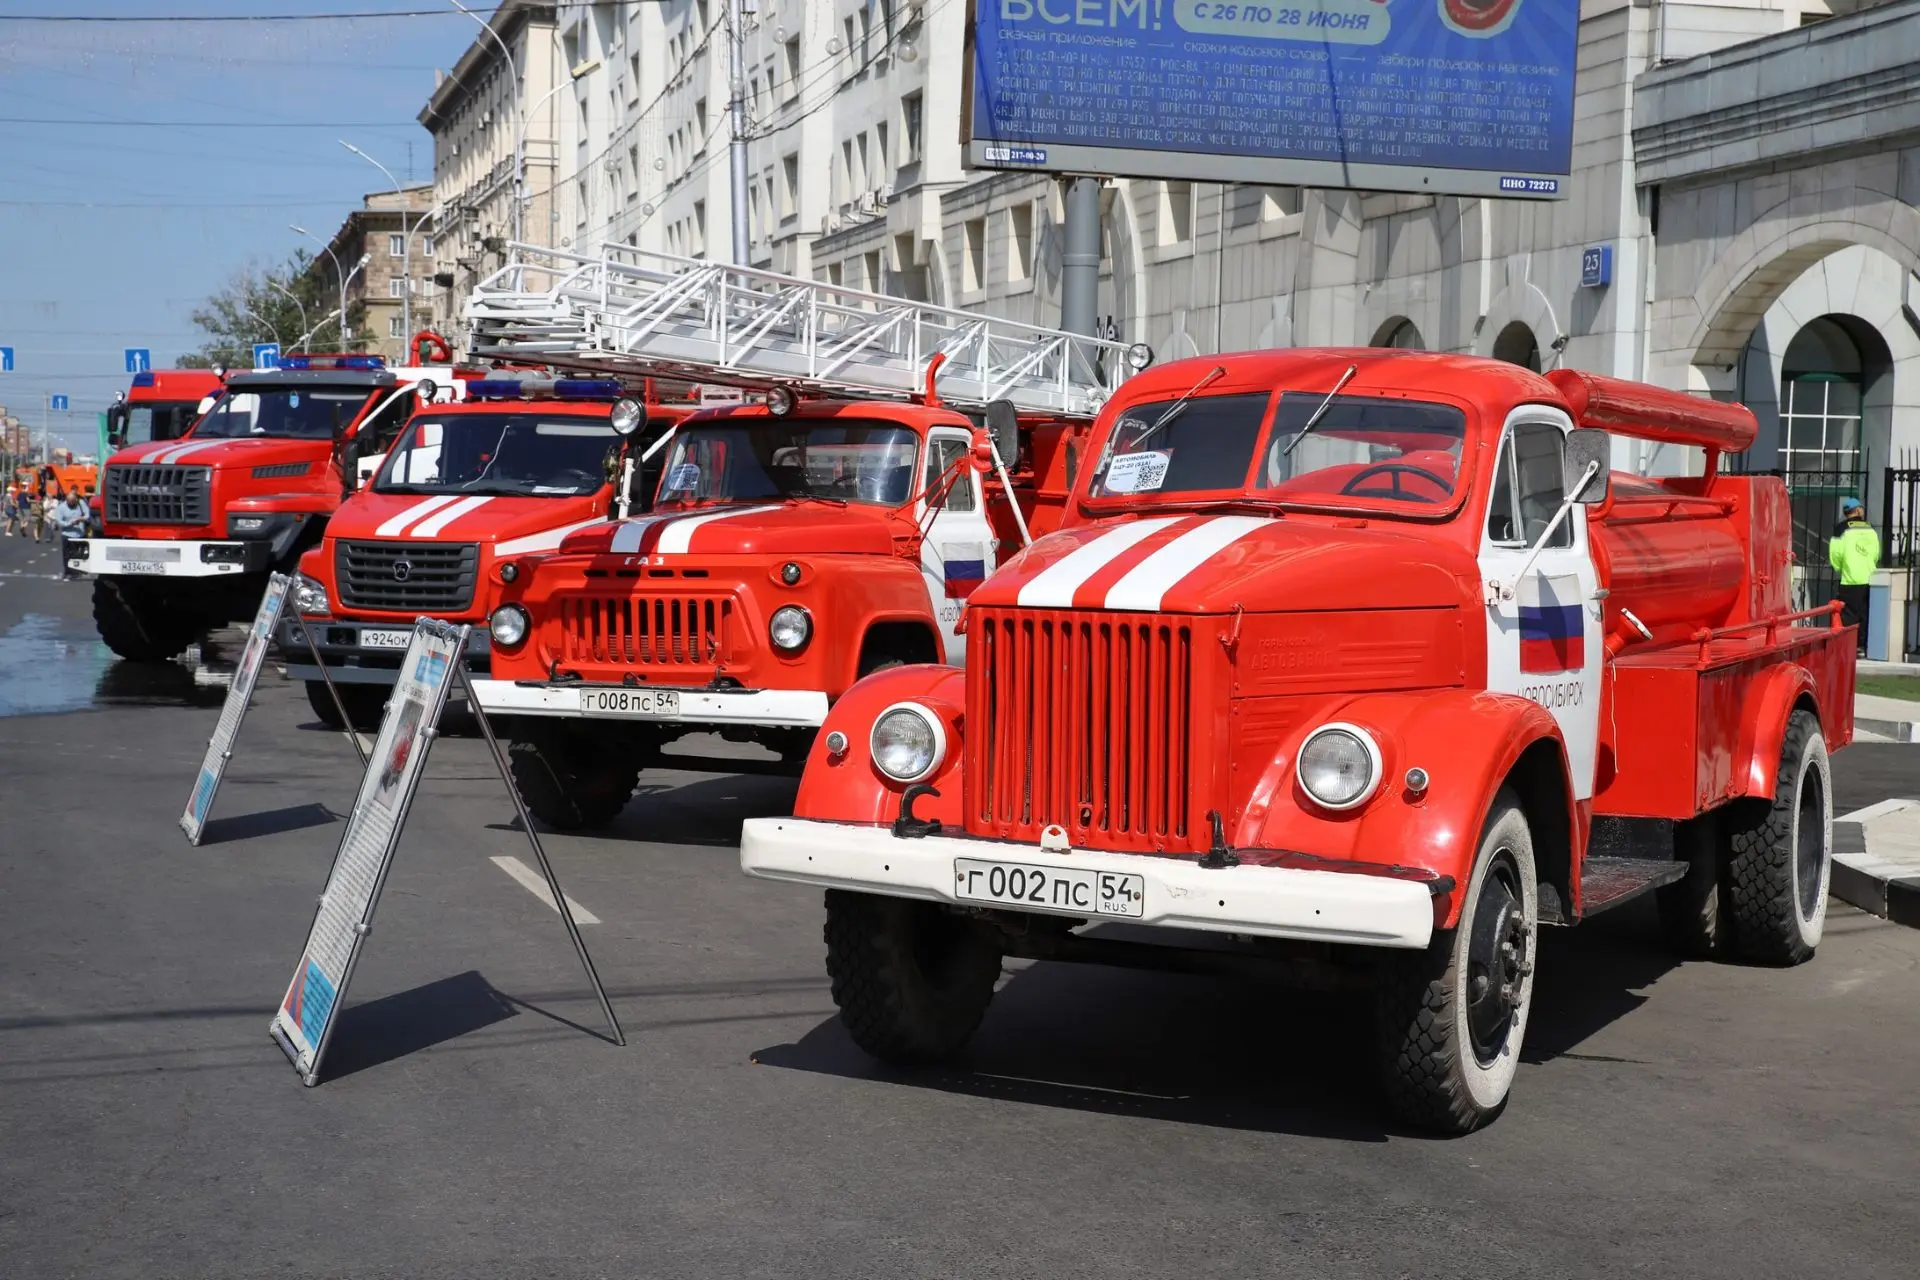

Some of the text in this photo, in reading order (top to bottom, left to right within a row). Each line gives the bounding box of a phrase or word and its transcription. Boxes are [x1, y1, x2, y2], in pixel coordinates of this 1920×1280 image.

[1194, 3, 1370, 30] С 26 ПО 28 ИЮНЯ
[1050, 32, 1136, 49] приложение
[1184, 41, 1329, 61] скажи кодовое слово
[1377, 54, 1424, 67] забери
[1428, 57, 1484, 71] подарок
[1499, 62, 1559, 76] магазине
[1528, 180, 1555, 191] 72273
[126, 485, 174, 495] URAL
[624, 556, 664, 566] ГАЗ
[364, 632, 408, 646] К924ОК
[656, 693, 672, 707] 54
[1101, 876, 1132, 902] 54
[1104, 901, 1128, 913] RUS
